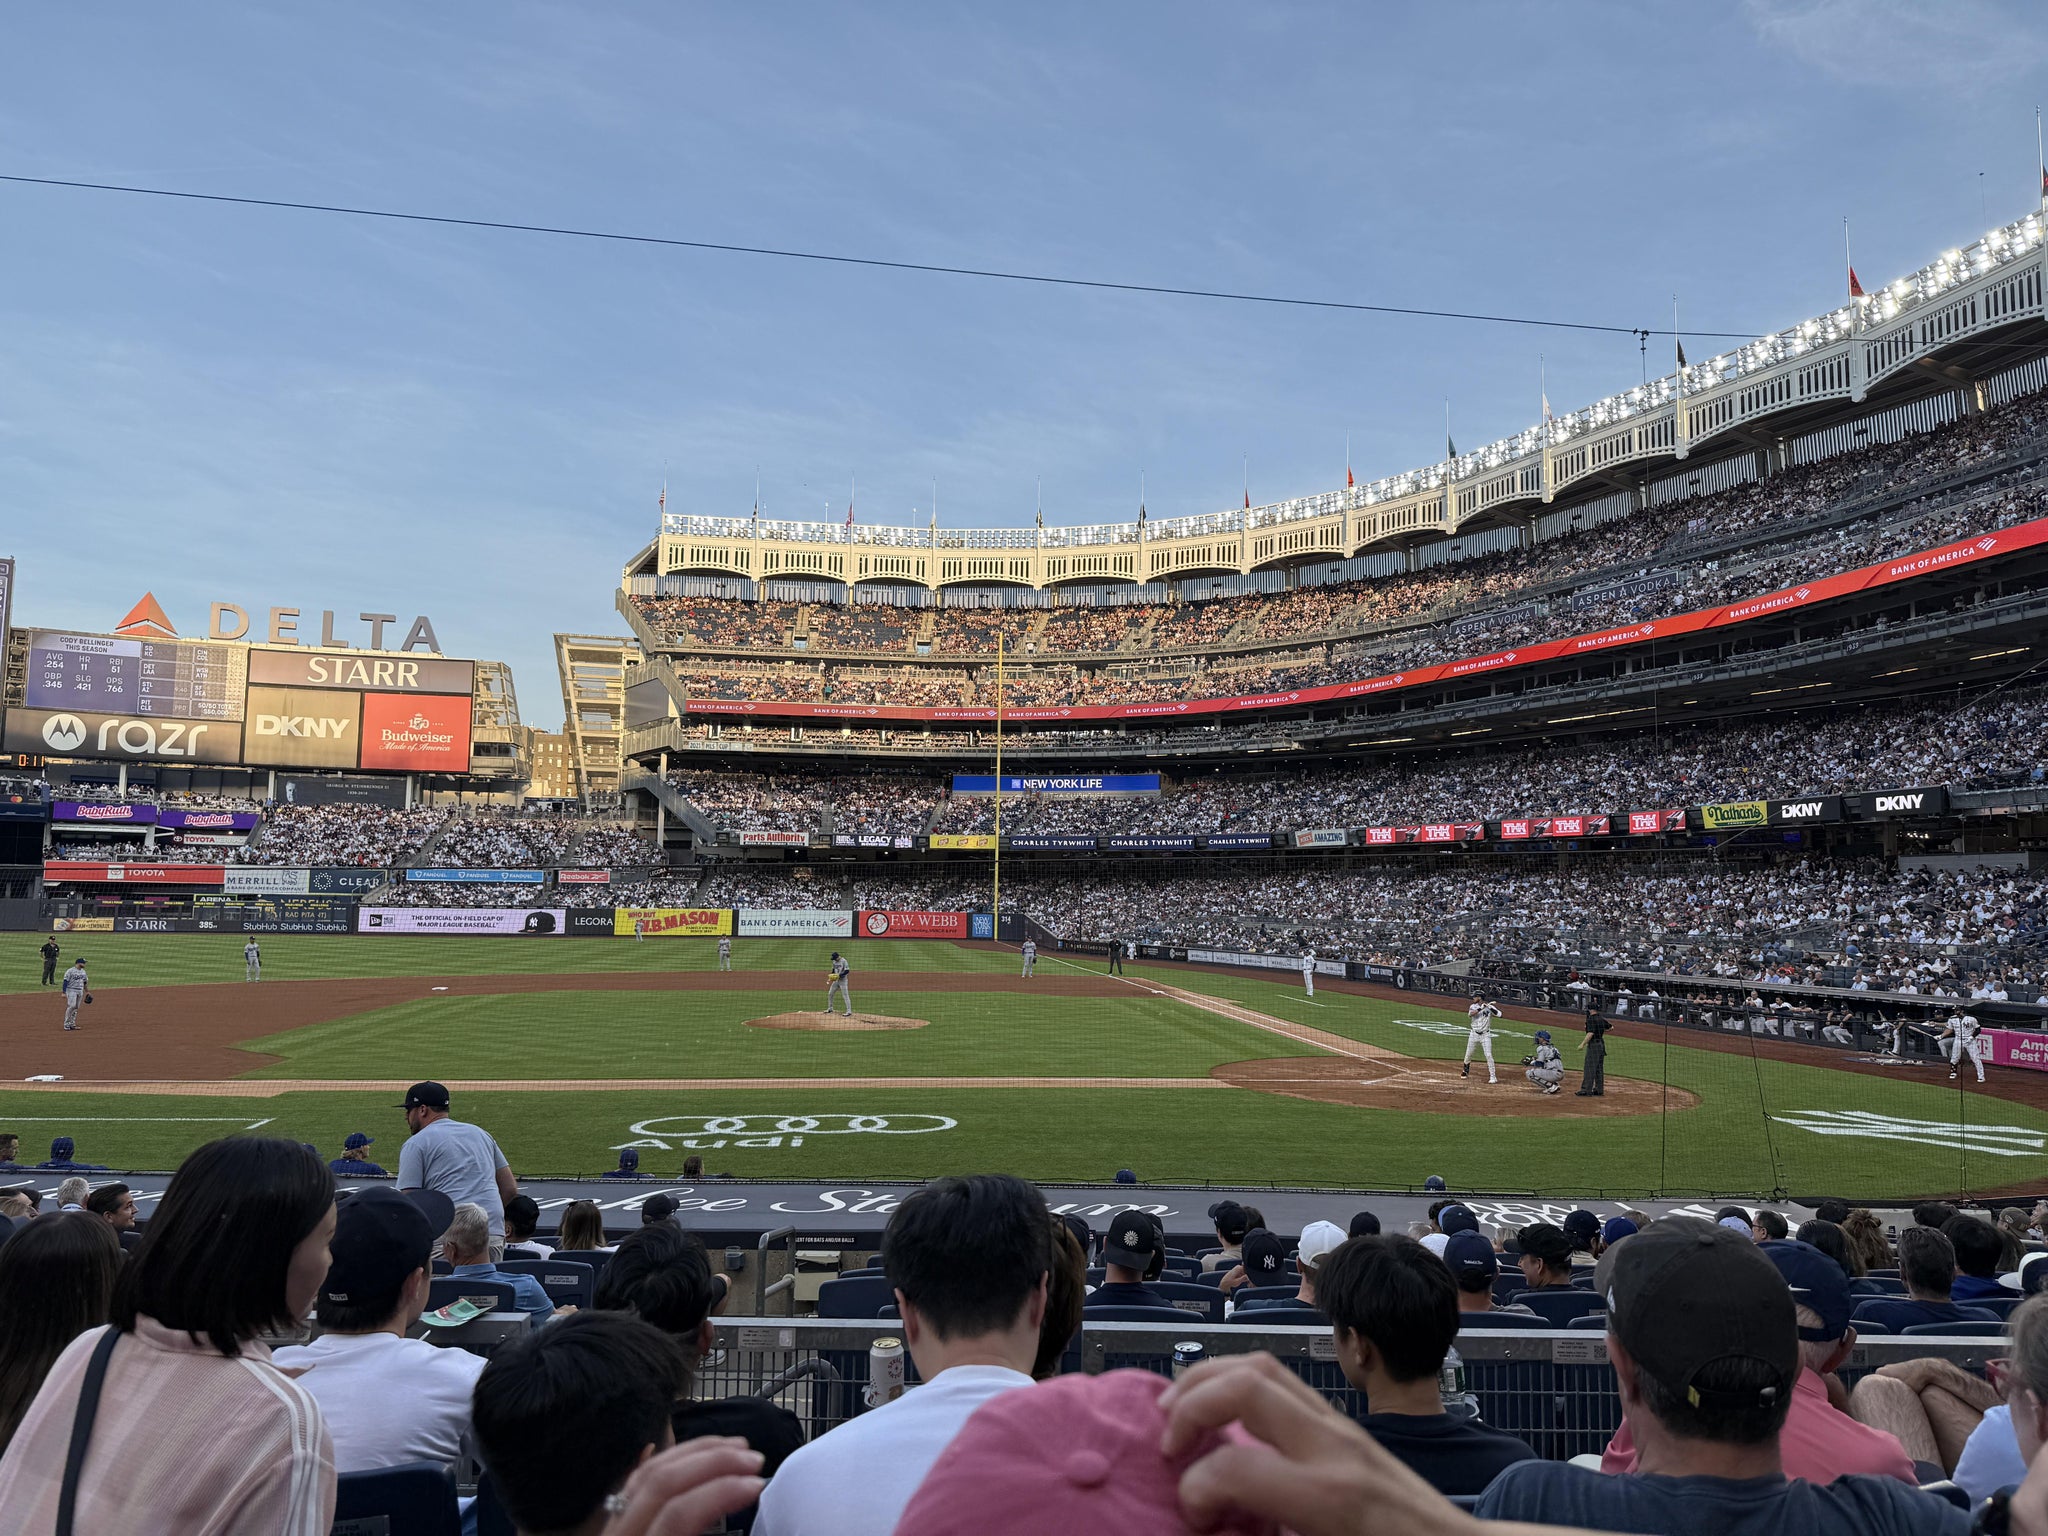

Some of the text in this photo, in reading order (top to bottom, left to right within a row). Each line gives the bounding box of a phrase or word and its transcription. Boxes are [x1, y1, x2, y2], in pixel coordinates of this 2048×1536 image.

[1891, 547, 1975, 576] BANK OF AMERICA
[1578, 577, 1670, 607] ASPEN VODKA
[1730, 595, 1794, 618] BANK OF AMERICA
[209, 602, 442, 652] DELTA
[1455, 609, 1531, 634] ASPEN VODKA
[60, 636, 114, 647] CODY BELLINGER
[1578, 630, 1639, 648] BANK OF AMERICA
[81, 645, 108, 653] SEASON
[45, 652, 64, 660] AVG
[78, 655, 91, 663] HR
[80, 663, 88, 671] 11
[109, 658, 123, 666] RBI
[1453, 664, 1470, 673] BANK
[1478, 657, 1504, 668] AMERICA
[44, 672, 62, 680] OBP
[307, 656, 419, 687] STARR
[75, 674, 92, 682] SLG
[106, 676, 123, 685] OPS
[42, 680, 63, 689] .345
[73, 683, 91, 691] .421
[104, 685, 124, 693] .766
[1371, 680, 1393, 689] AMERICA
[1264, 696, 1289, 704] AMERICA
[255, 714, 351, 739] DKNY
[97, 719, 208, 756] razr
[381, 729, 453, 743] Budweiser
[379, 741, 451, 752] Made of America
[18, 754, 46, 767] 0:11
[1023, 779, 1103, 789] NEW YORK LIFE
[1875, 794, 1924, 812] DKNY
[1707, 804, 1761, 821] Nathan's
[1781, 802, 1823, 819] DKNY
[1556, 819, 1580, 831] THK
[1632, 814, 1657, 827] THK
[1426, 825, 1450, 838] THK
[1504, 822, 1527, 833] THK
[743, 832, 805, 842] Parts Authority
[859, 835, 892, 843] LEGACY
[1314, 832, 1343, 842] AMAZING
[1370, 828, 1392, 840] THK
[127, 869, 166, 877] TOYOTA
[560, 873, 590, 881] Reebok
[227, 877, 279, 885] MERRILL
[339, 877, 381, 887] CLEAR
[126, 920, 167, 930] STARR
[575, 917, 614, 926] LEGORA
[890, 915, 958, 927] F.W. WEBB
[243, 922, 348, 932] StubHub StubHub StubHub
[2010, 1048, 2041, 1062] Best
[608, 1136, 804, 1151] Audi
[1263, 1255, 1275, 1269] NY
